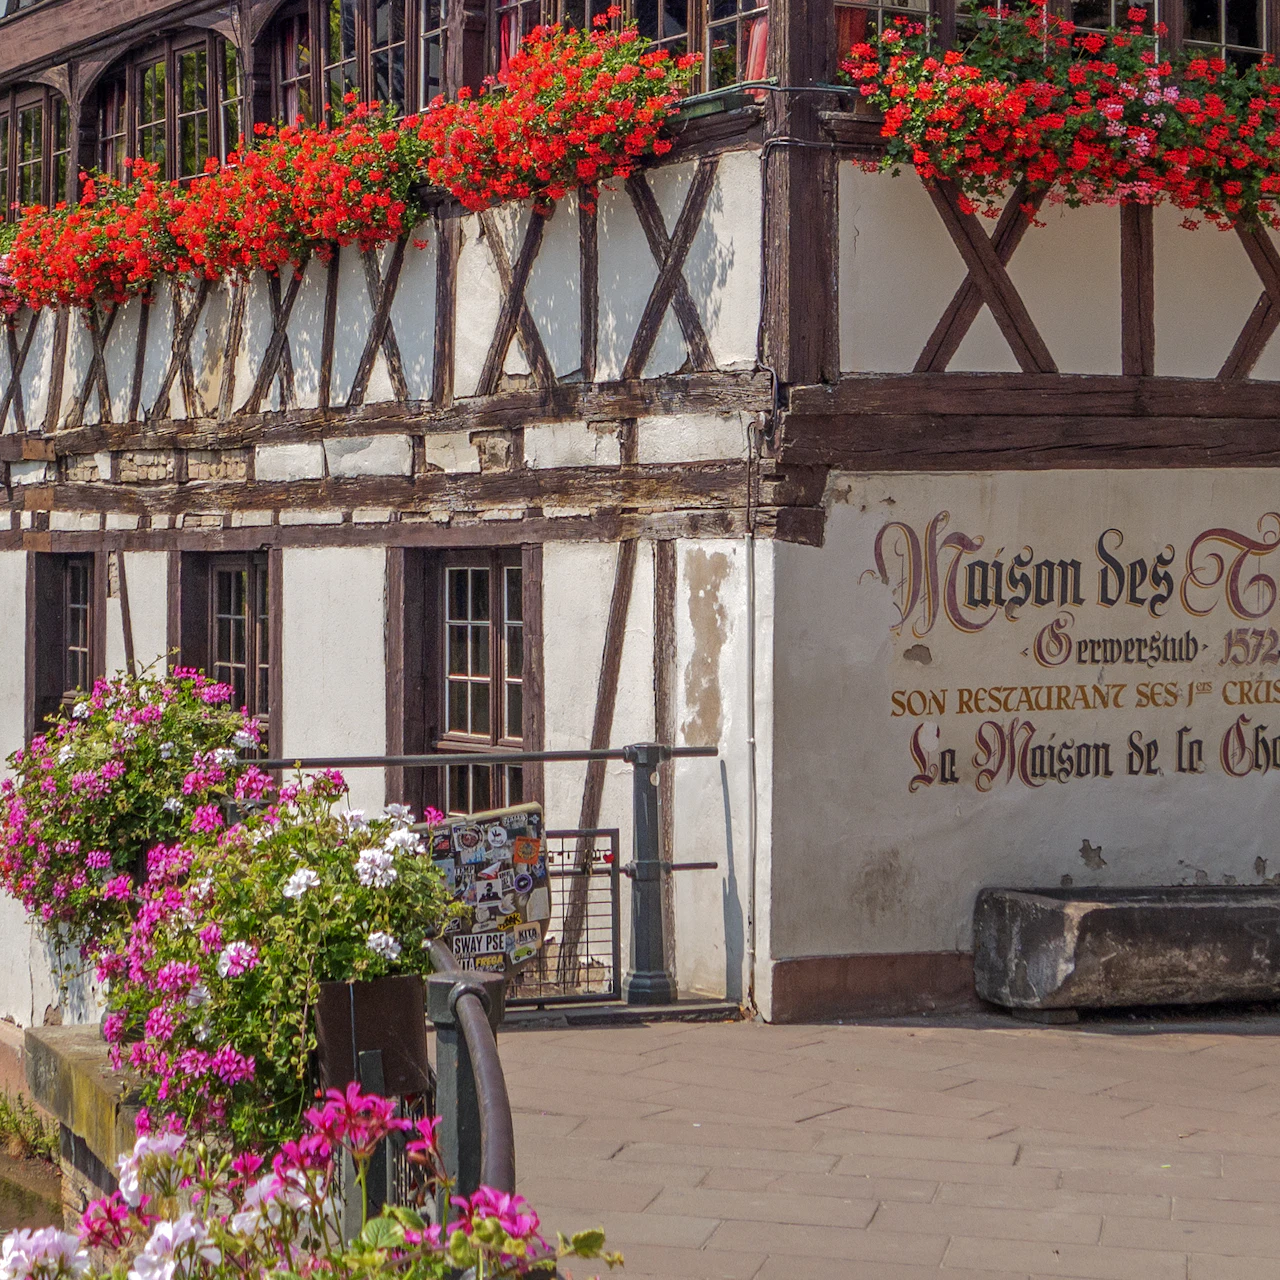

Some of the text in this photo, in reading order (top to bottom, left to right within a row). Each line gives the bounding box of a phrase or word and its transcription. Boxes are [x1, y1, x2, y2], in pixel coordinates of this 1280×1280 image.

[860, 510, 1086, 638] Maison
[1095, 528, 1175, 618] des
[1218, 627, 1280, 667] 1572
[891, 689, 948, 717] SON
[956, 684, 1127, 714] RESTAURANT
[1135, 681, 1178, 708] SES
[908, 721, 960, 793] La
[972, 717, 1114, 793] Maison
[1126, 730, 1160, 776] de
[1175, 725, 1204, 775] la
[454, 933, 505, 954] SWAY PSE
